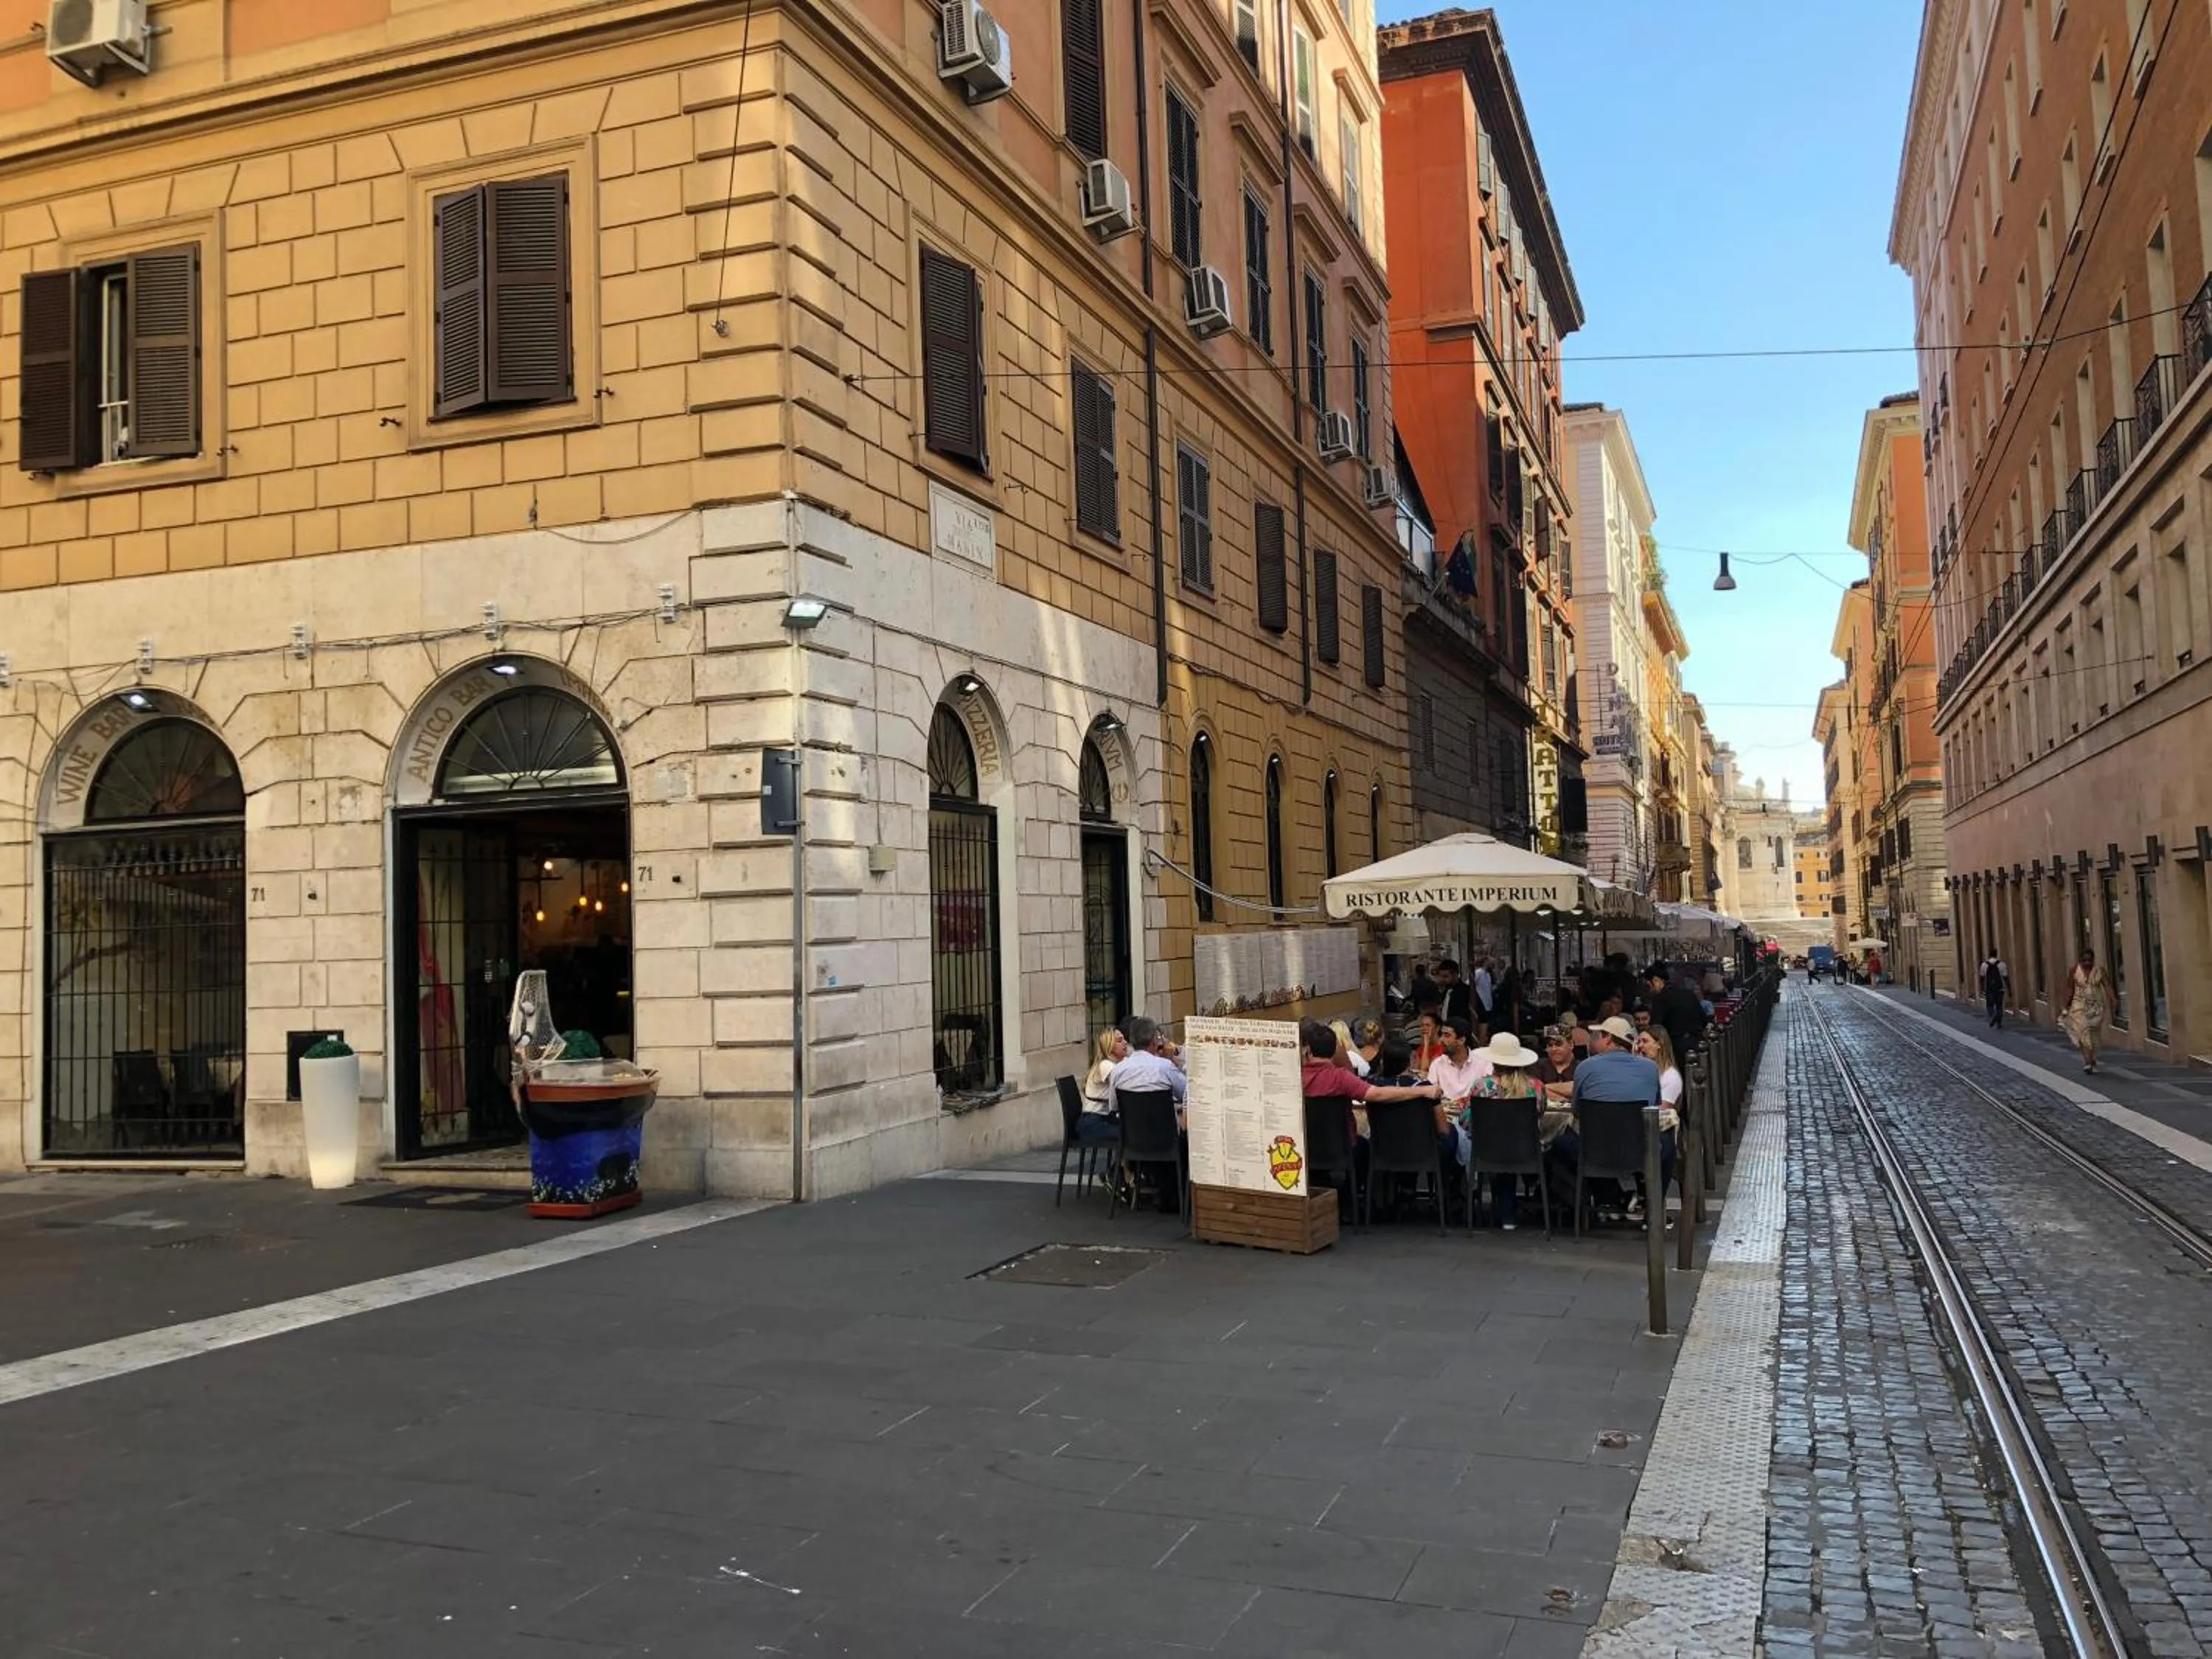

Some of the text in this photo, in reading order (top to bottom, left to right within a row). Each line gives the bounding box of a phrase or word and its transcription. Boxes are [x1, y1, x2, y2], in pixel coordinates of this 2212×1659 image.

[406, 675, 496, 782] ANTICO BAR
[957, 692, 999, 779] PIZZERIA
[57, 707, 132, 806] WINE BAR
[251, 887, 265, 902] 71
[637, 866, 653, 882] 71
[1346, 886, 1558, 908] RISTORANTE IMPERIUM
